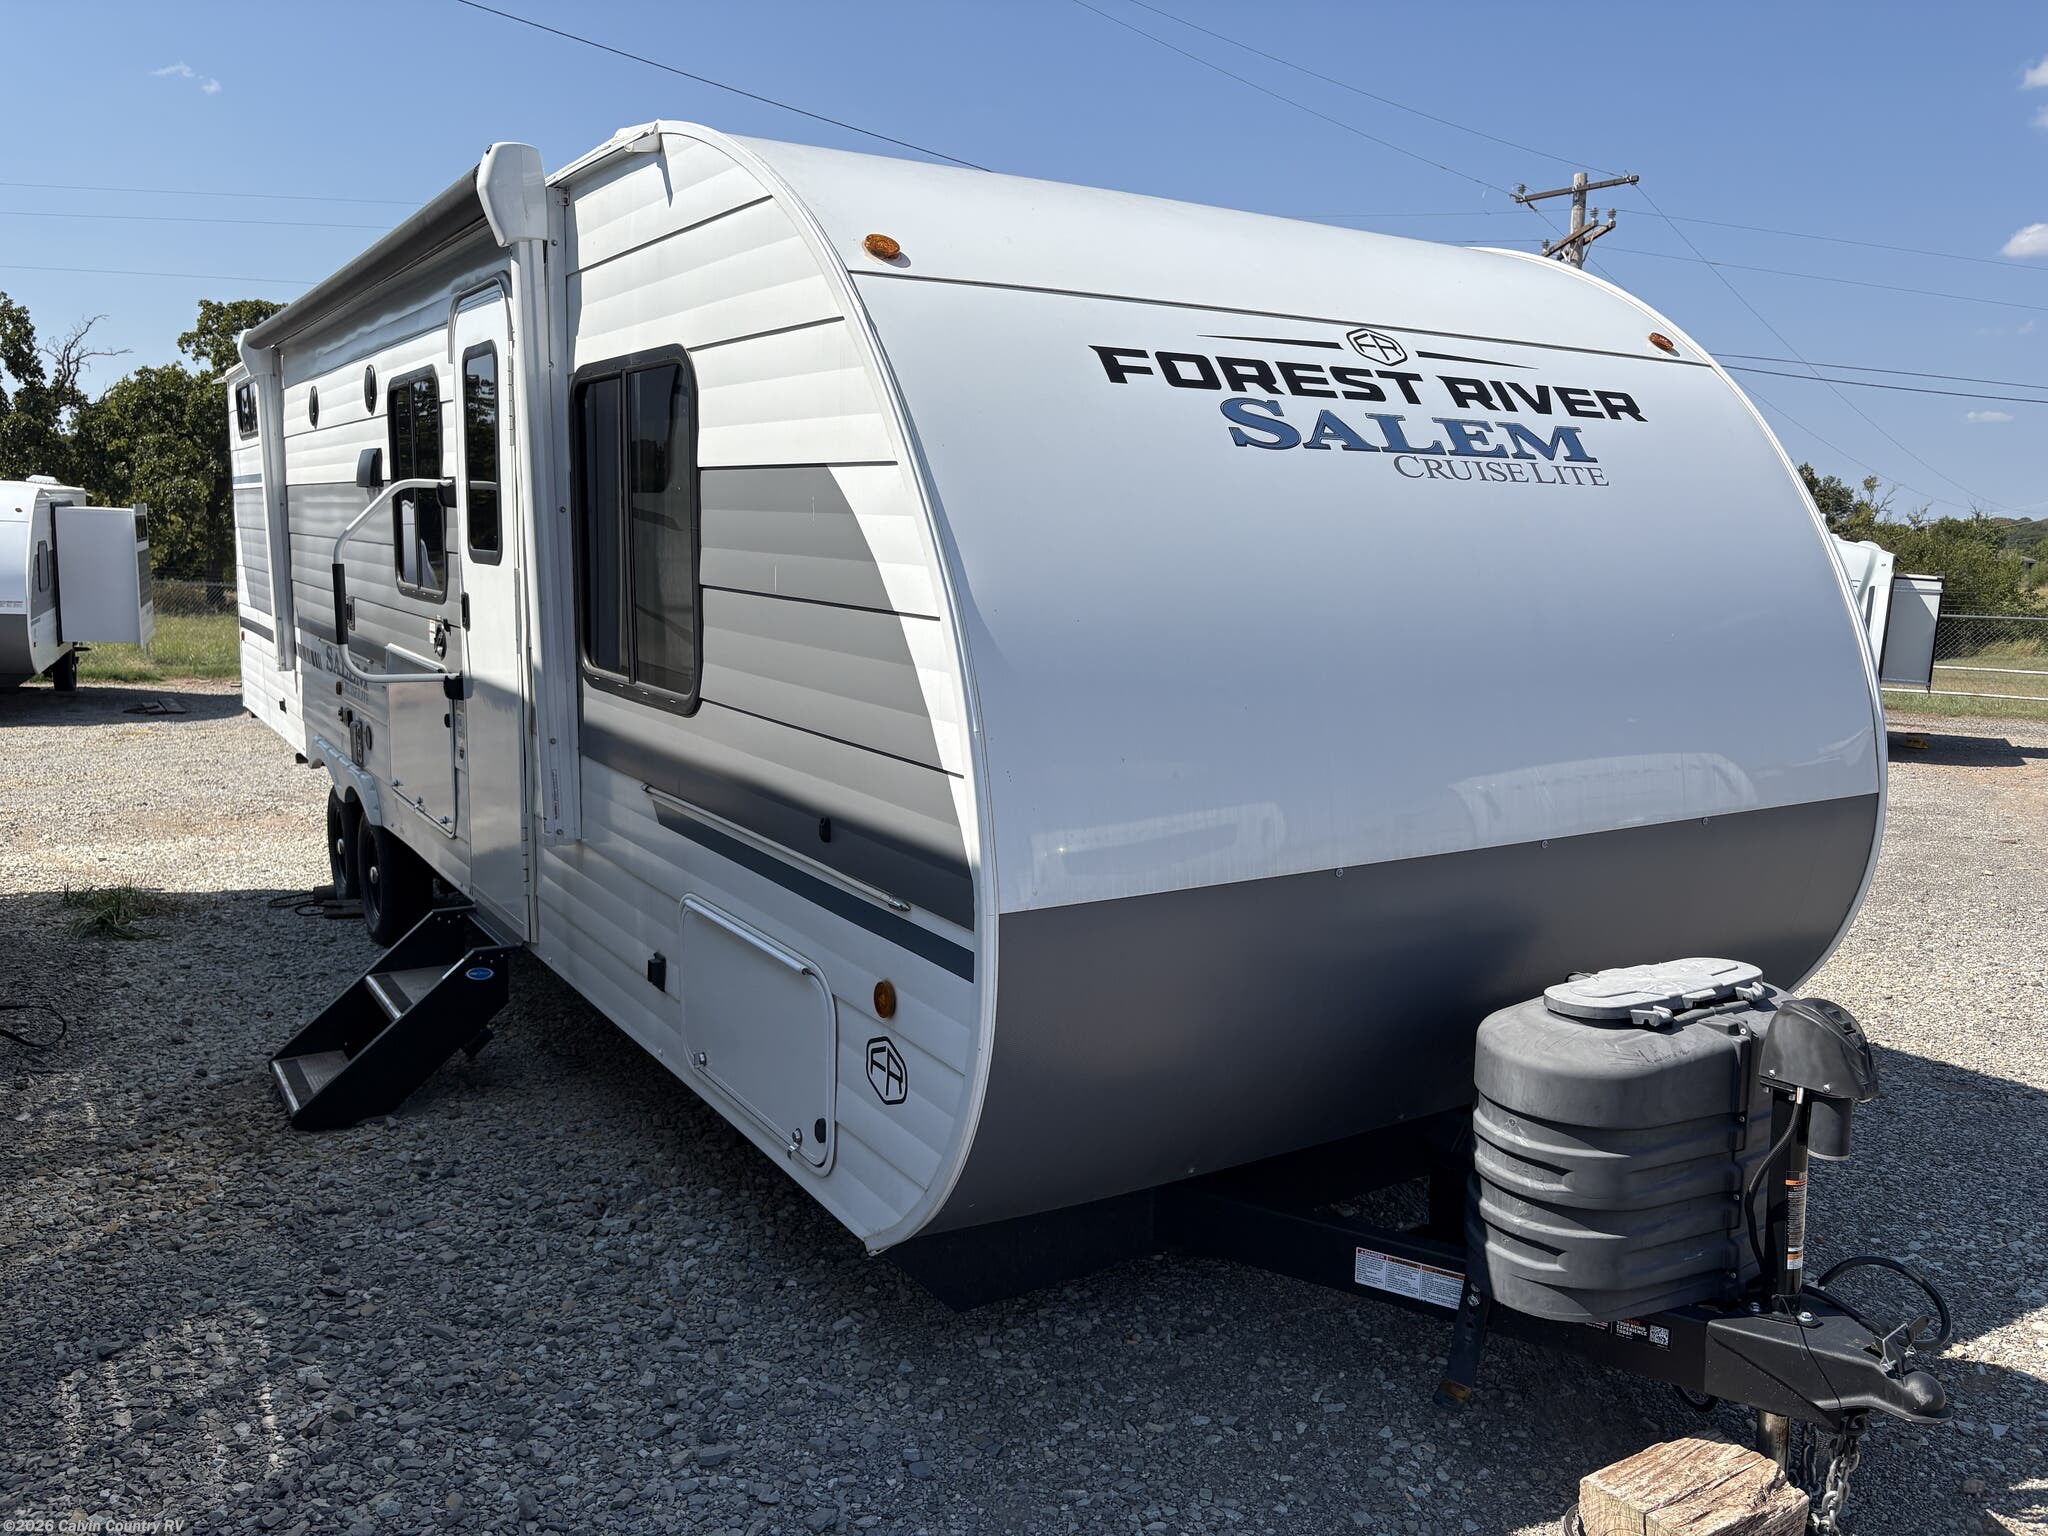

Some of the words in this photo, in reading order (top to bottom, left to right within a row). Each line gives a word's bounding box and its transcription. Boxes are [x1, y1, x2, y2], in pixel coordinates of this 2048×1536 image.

[1088, 344, 1424, 406] FOREST
[1435, 374, 1650, 424] RIVER
[1218, 396, 1599, 464] SALEM
[1616, 1324, 1648, 1337] EXPERIENCE
